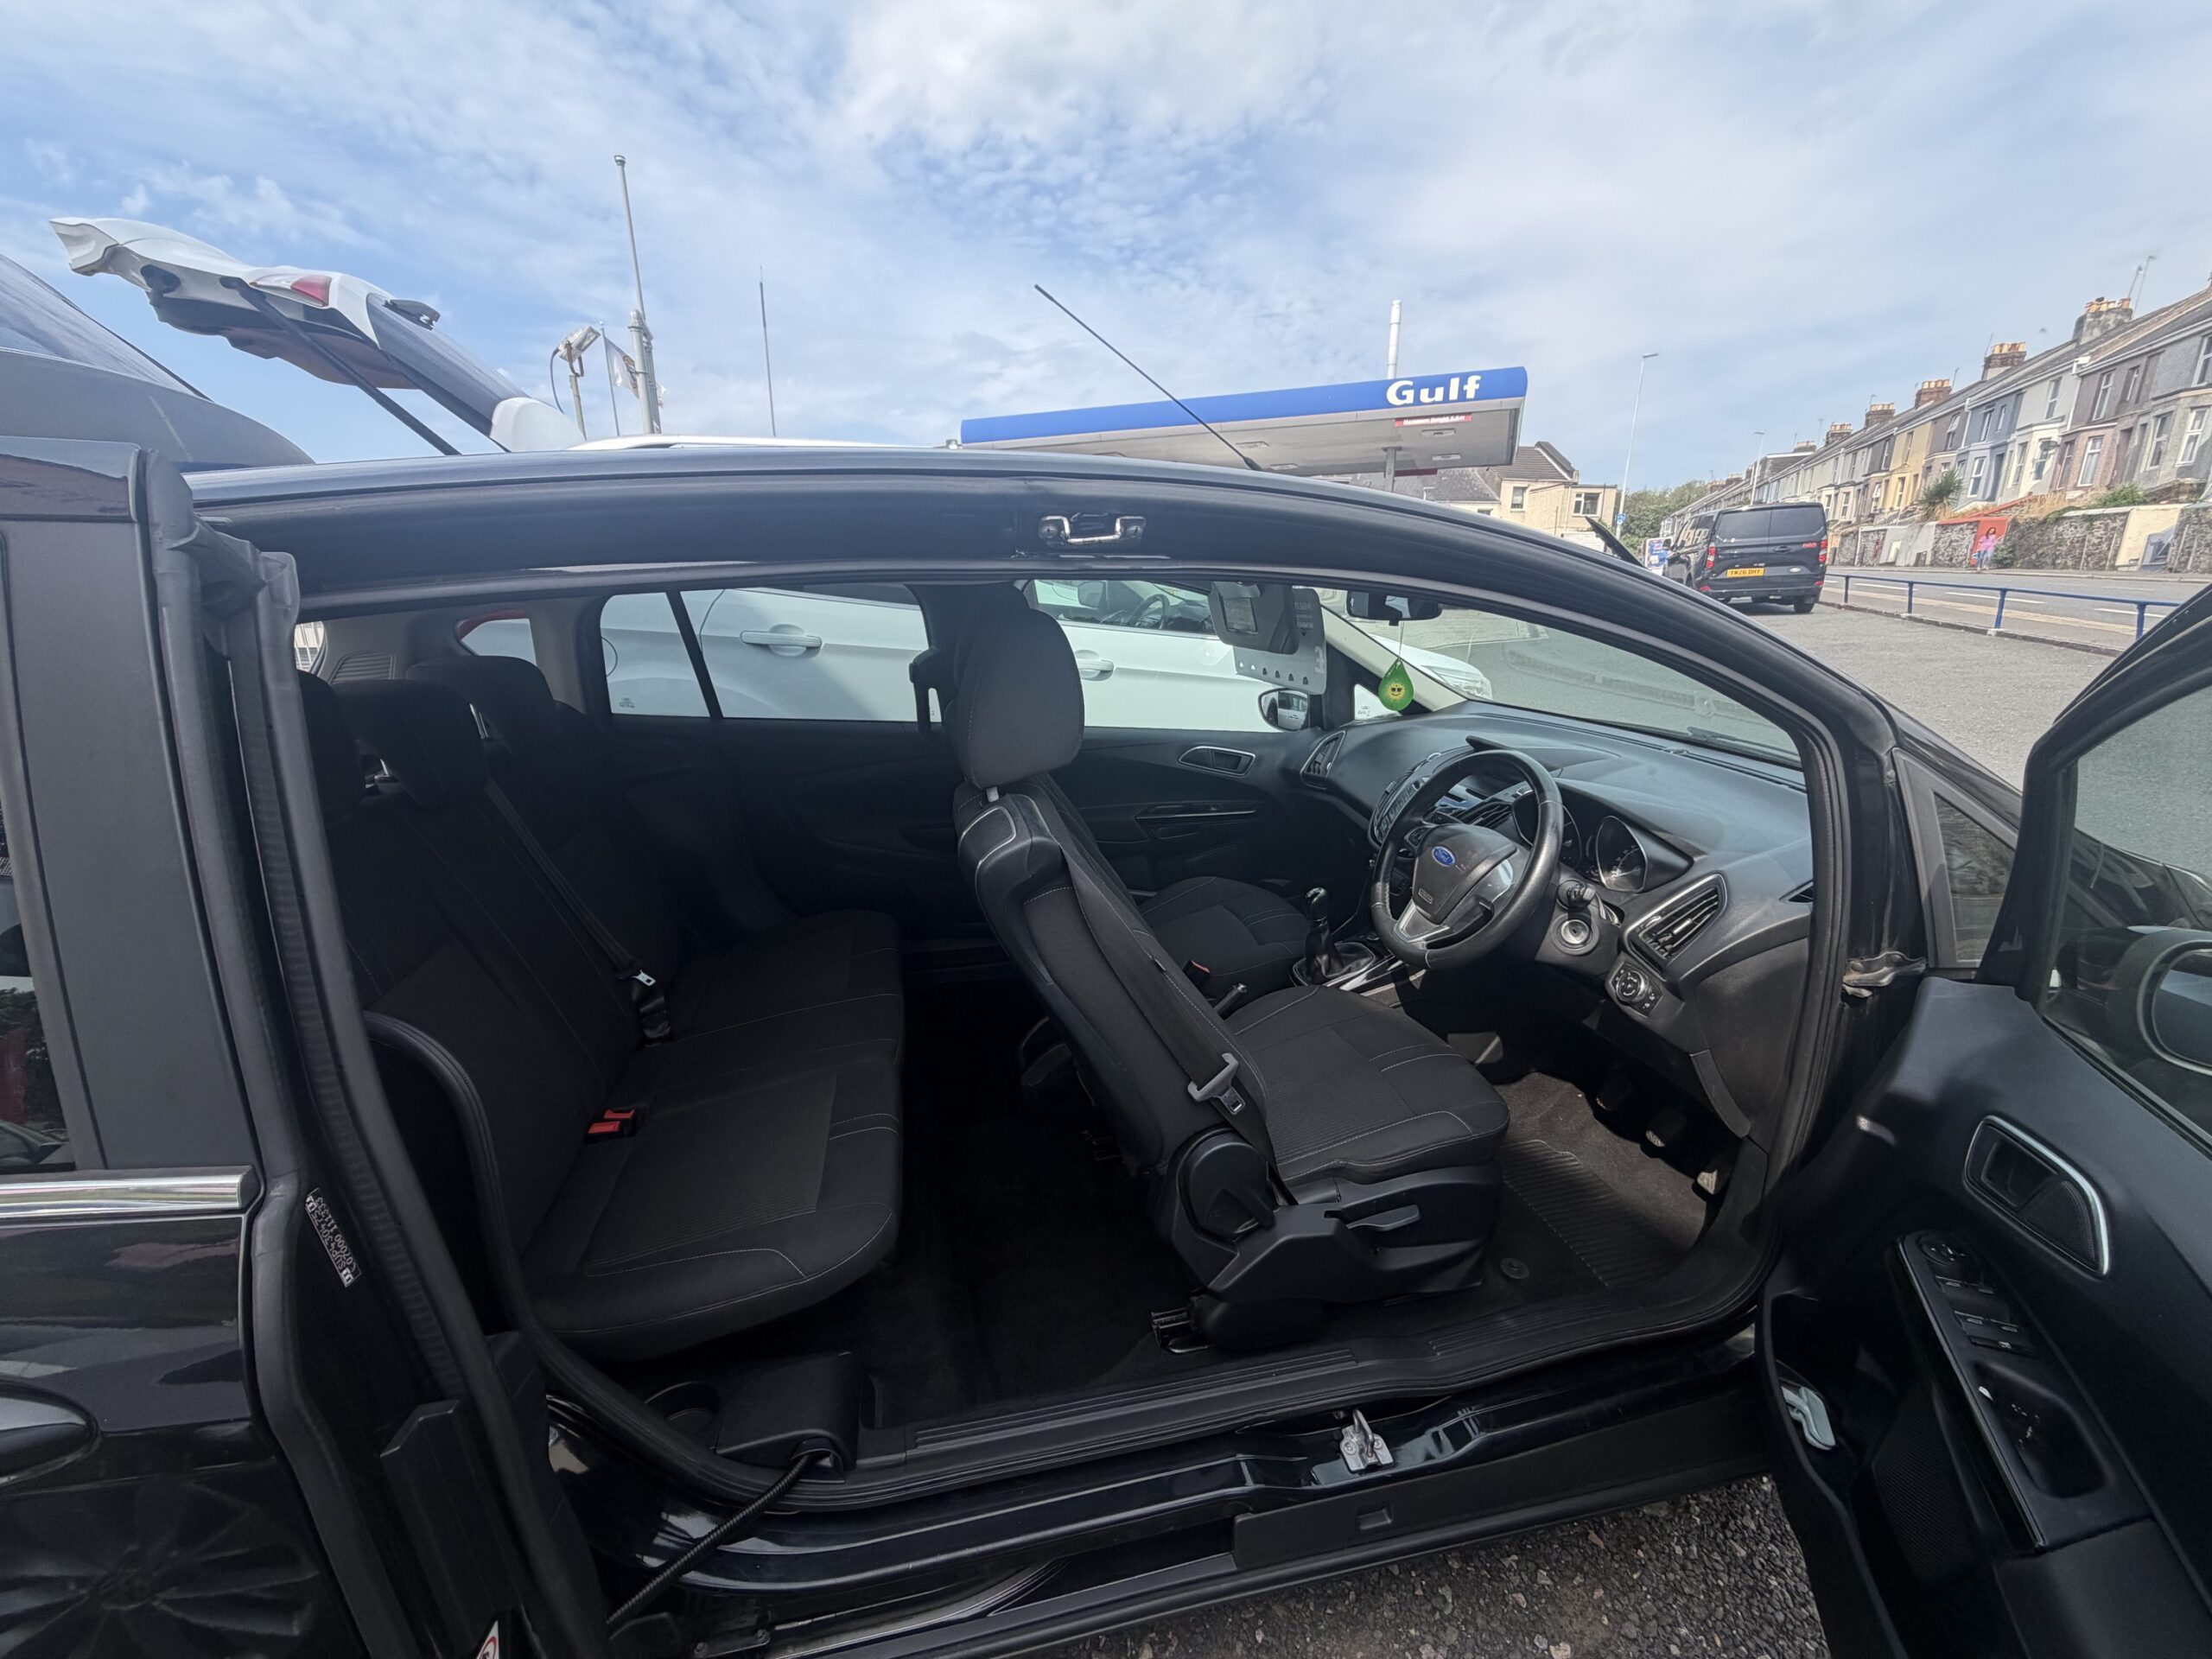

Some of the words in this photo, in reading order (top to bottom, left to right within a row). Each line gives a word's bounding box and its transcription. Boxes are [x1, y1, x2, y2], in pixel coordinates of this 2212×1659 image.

[1386, 375, 1482, 406] Gulf
[315, 1197, 338, 1232] 111333
[334, 1234, 353, 1266] 07000
